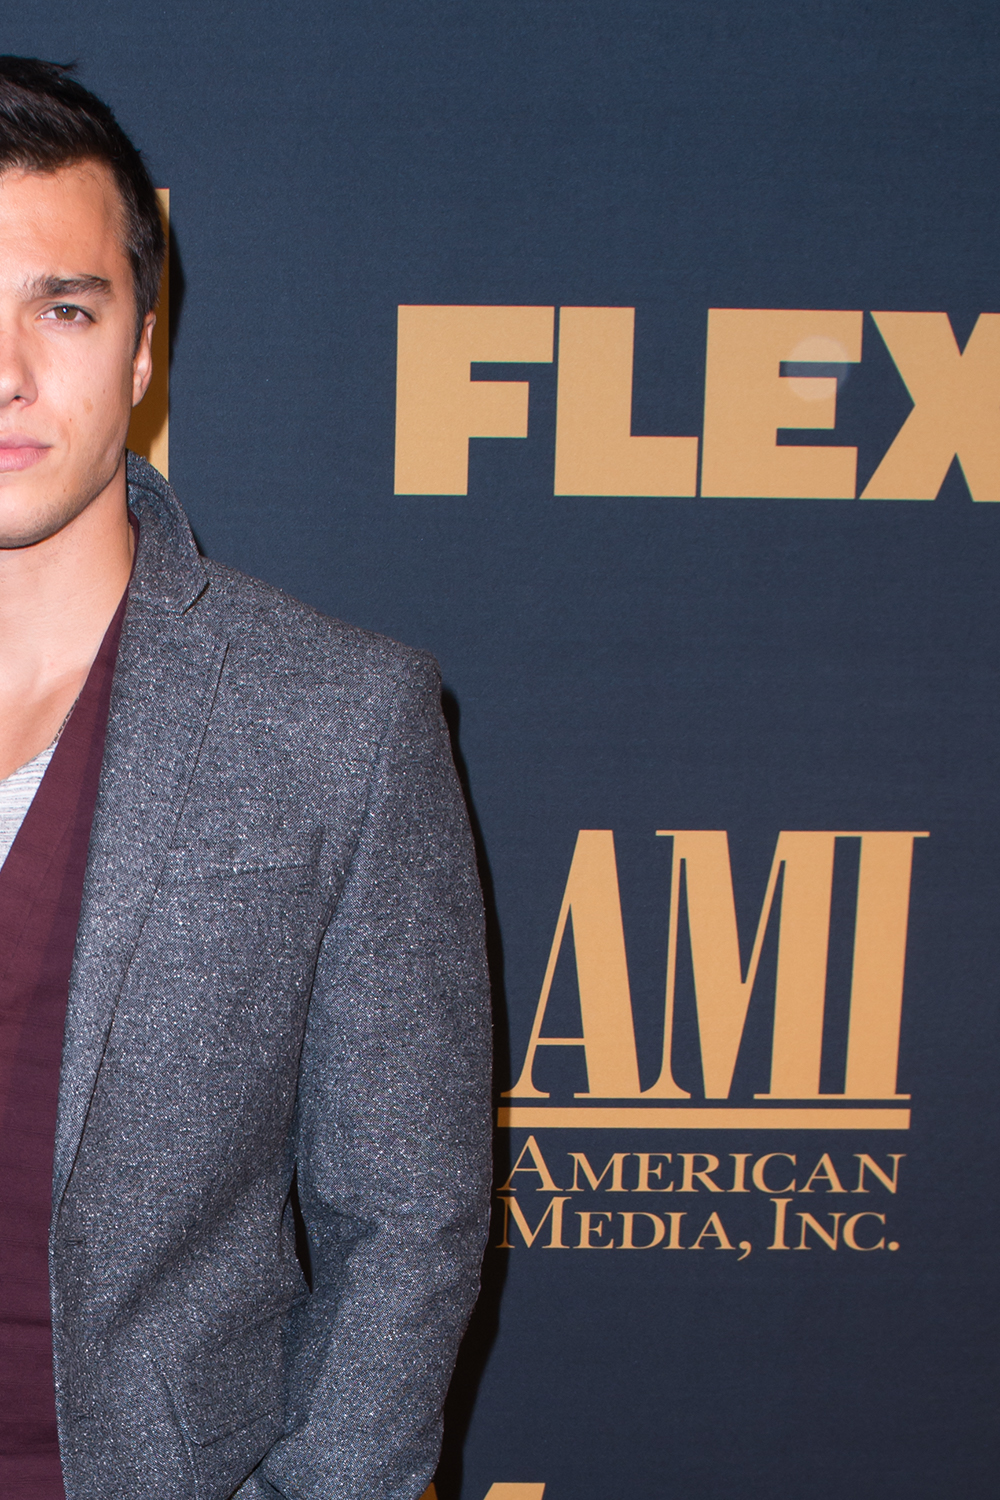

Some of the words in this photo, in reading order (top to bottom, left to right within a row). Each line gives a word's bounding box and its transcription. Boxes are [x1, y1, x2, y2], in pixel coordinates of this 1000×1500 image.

[394, 304, 1000, 502] FLEX
[500, 829, 930, 1099] AMI
[496, 1135, 907, 1194] AMERICAN
[766, 1198, 900, 1251] INC.
